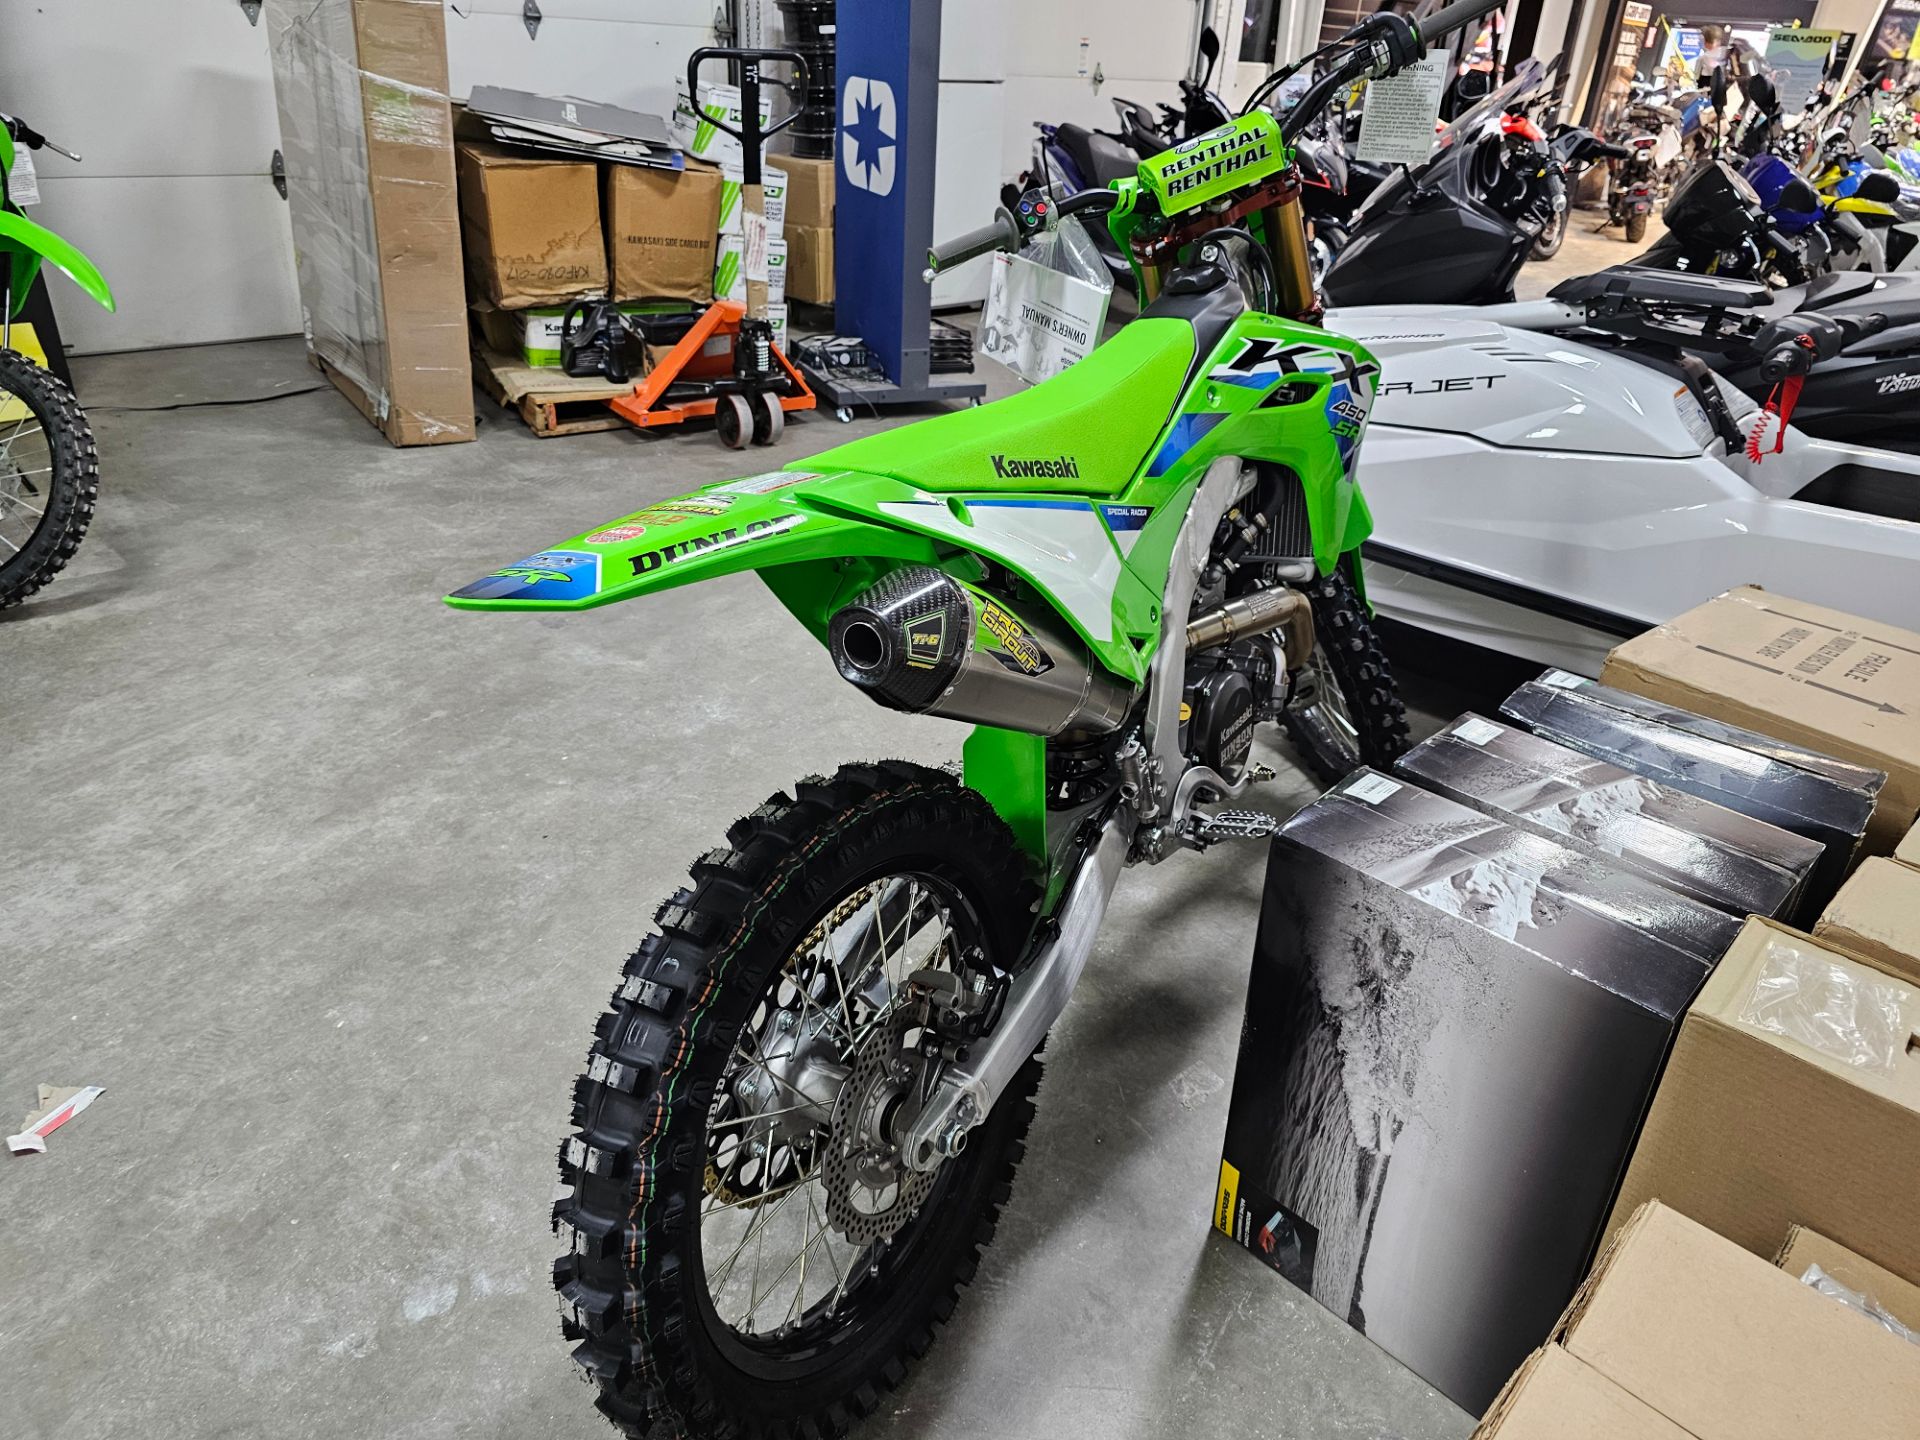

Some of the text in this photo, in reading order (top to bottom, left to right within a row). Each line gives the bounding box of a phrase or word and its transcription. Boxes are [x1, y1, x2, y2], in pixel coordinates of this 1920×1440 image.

[1162, 127, 1267, 178] RENTHAL
[1168, 144, 1272, 197] RENTHAL
[1022, 304, 1052, 329] MANUAL
[1053, 319, 1087, 346] OWNER'S
[1359, 333, 1445, 341] ERUNNER
[1228, 336, 1380, 398] KX
[1331, 400, 1367, 422] 450
[991, 455, 1079, 478] Kawasaki
[1107, 507, 1147, 517] SPECIAL RACER
[628, 513, 797, 577] DUNLOP
[985, 602, 1022, 639] PRO
[981, 612, 1038, 673] CIRCUIT
[1843, 652, 1892, 683] FRAGILE
[1220, 703, 1253, 745] Kawasaki
